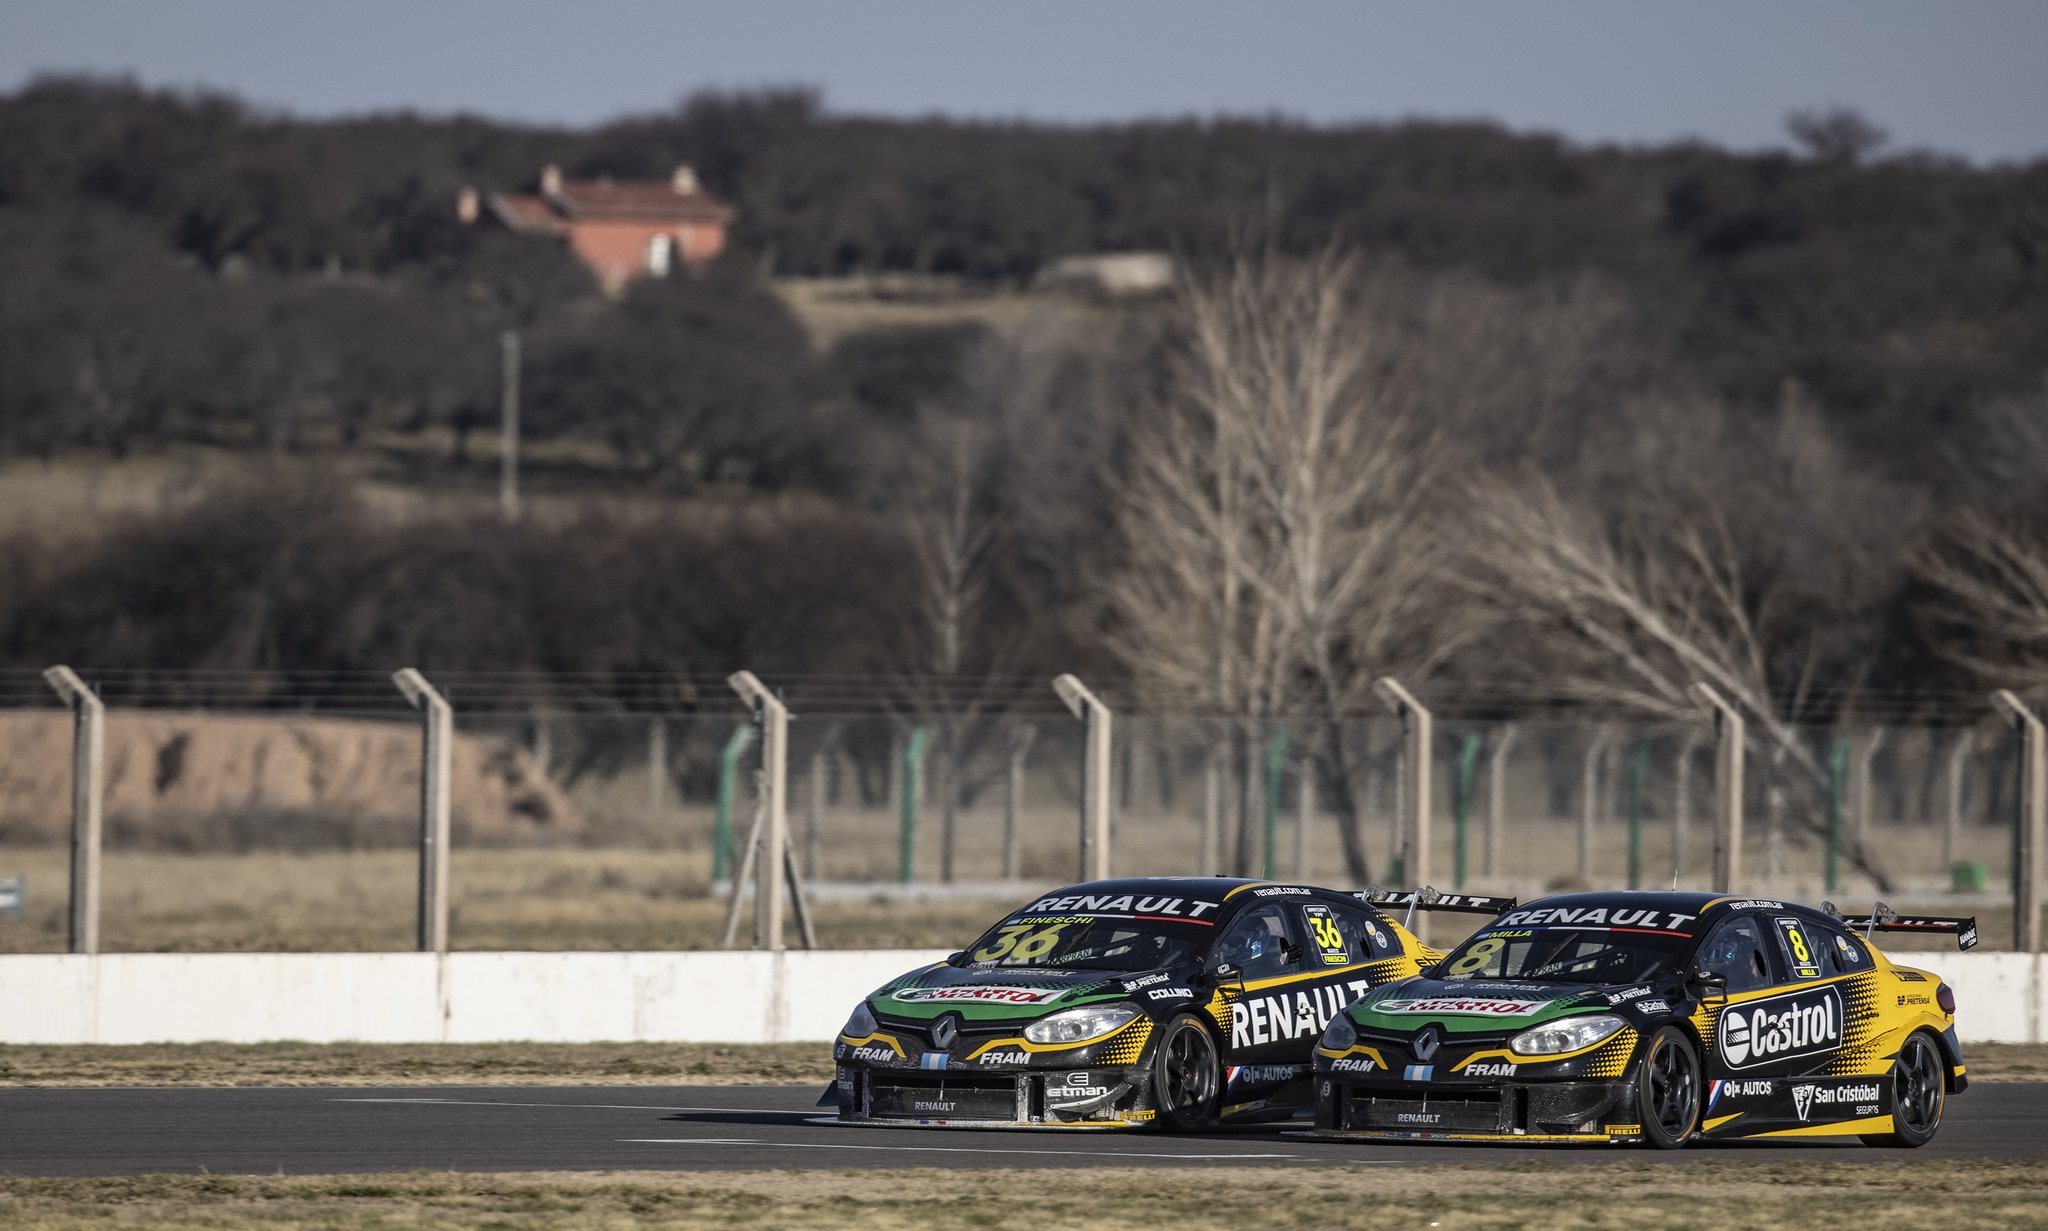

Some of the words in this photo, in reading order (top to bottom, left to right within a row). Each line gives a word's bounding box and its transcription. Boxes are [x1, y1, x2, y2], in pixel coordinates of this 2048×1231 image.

[1253, 887, 1312, 897] renault.com.ar
[1025, 895, 1219, 918] RENAULT
[1728, 900, 1784, 910] renault.com.ar
[1019, 917, 1094, 925] FINESCHI
[1496, 908, 1697, 931] RENAULT
[1309, 918, 1343, 949] 36
[1488, 929, 1533, 939] MILLA
[973, 924, 1072, 963] 36
[1789, 929, 1809, 962] 8
[1449, 937, 1506, 975] 8
[1147, 988, 1194, 1000] COLLINO
[1907, 997, 1930, 1005] PRETENSA
[1751, 994, 1837, 1057] Castrol
[852, 1047, 895, 1062] FRAM
[979, 1051, 1032, 1065] FRAM
[1330, 1059, 1376, 1072] FRAM
[1463, 1064, 1518, 1077] FRAM
[1263, 1066, 1293, 1081] AUTOS
[1046, 1085, 1108, 1097] etman
[1742, 1081, 1772, 1096] AUTOS
[1815, 1086, 1835, 1103] San
[1836, 1083, 1880, 1103] Cristóbal
[914, 1101, 956, 1111] RENAULT
[1397, 1113, 1441, 1124] RENAULT
[1604, 1124, 1641, 1135] PIRELLI
